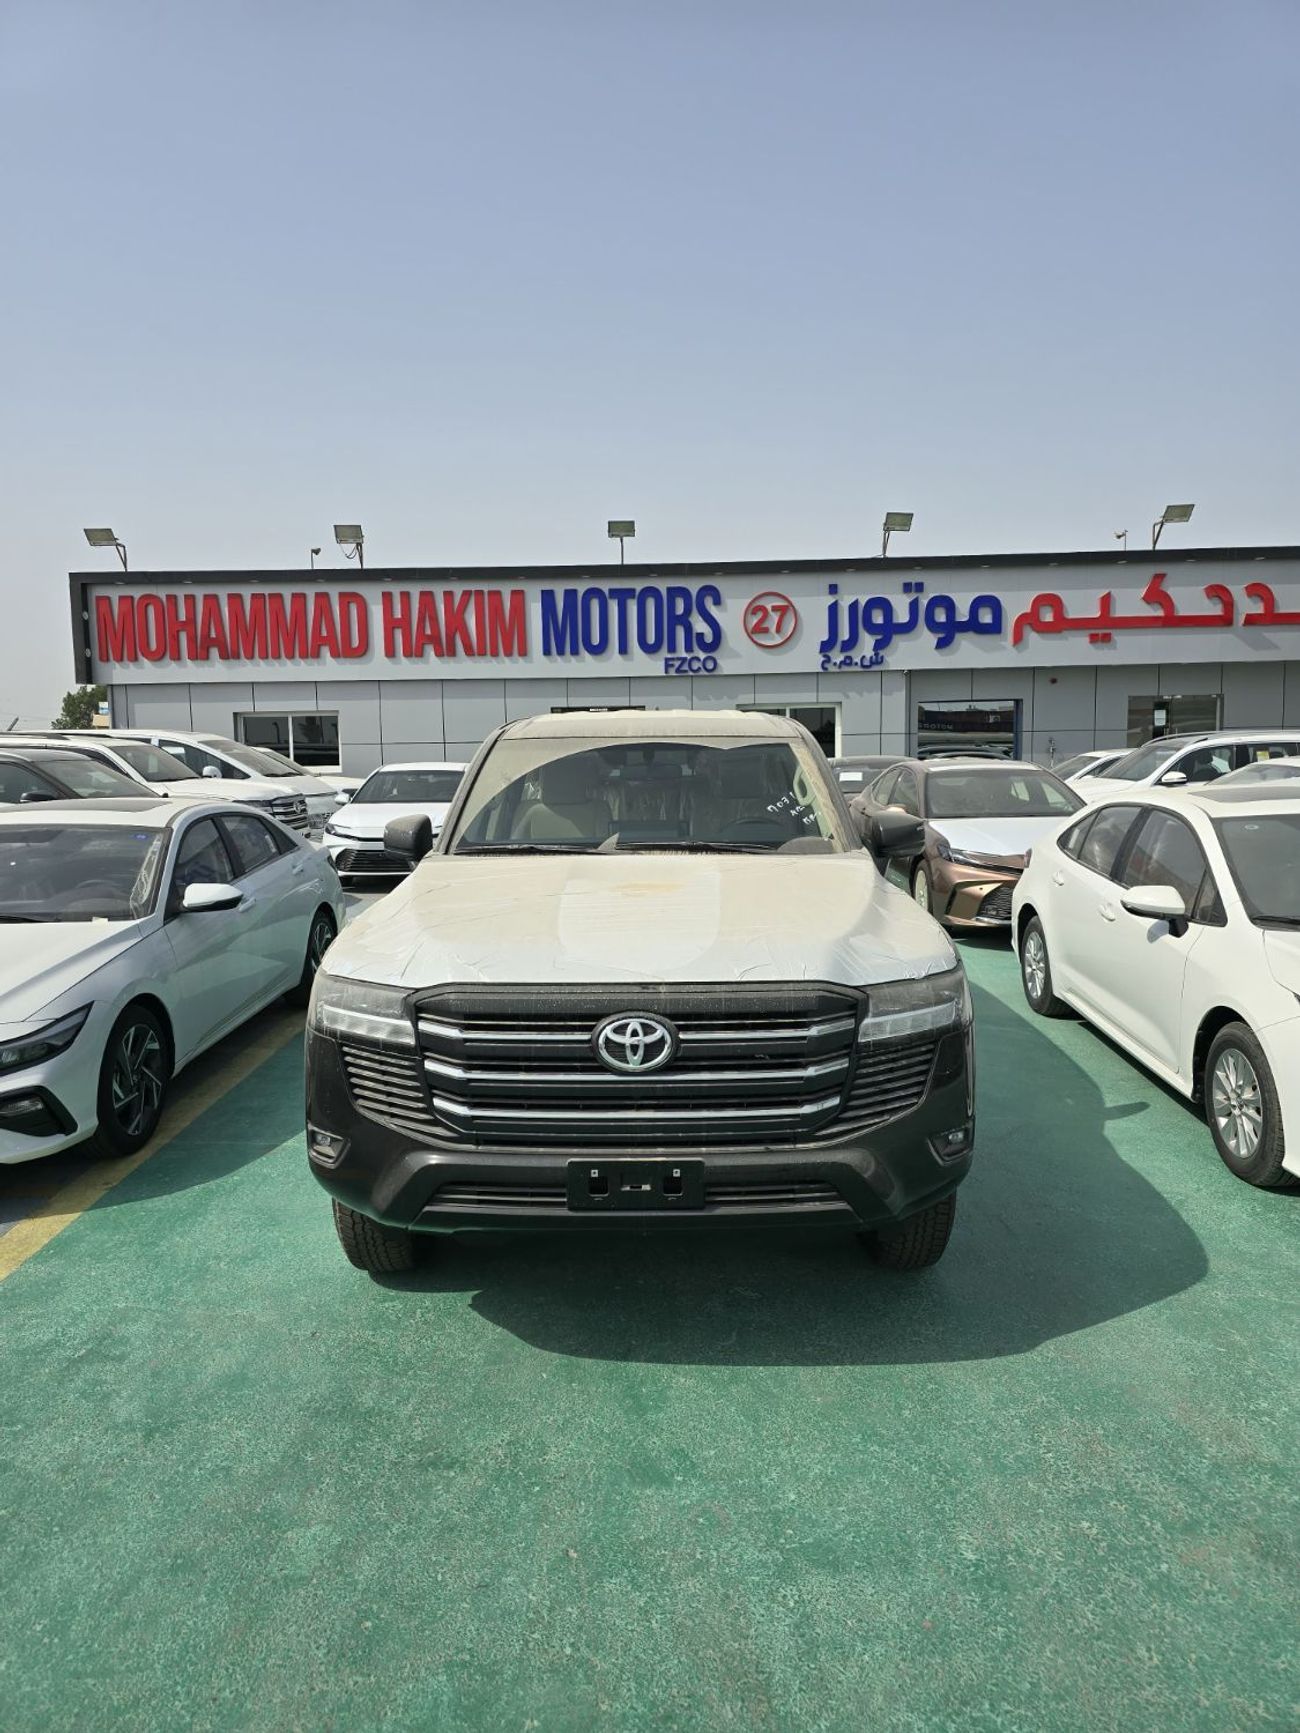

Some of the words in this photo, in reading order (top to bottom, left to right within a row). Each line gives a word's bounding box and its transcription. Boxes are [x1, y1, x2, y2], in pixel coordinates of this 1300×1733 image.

[95, 592, 368, 663] MOHAMMAD
[382, 588, 528, 659] HAKIM
[541, 586, 721, 656] MOTORS
[751, 604, 790, 635] 27
[819, 582, 1003, 655] موتورز
[1012, 573, 1235, 647] حكيم
[664, 656, 717, 674] FZCO
